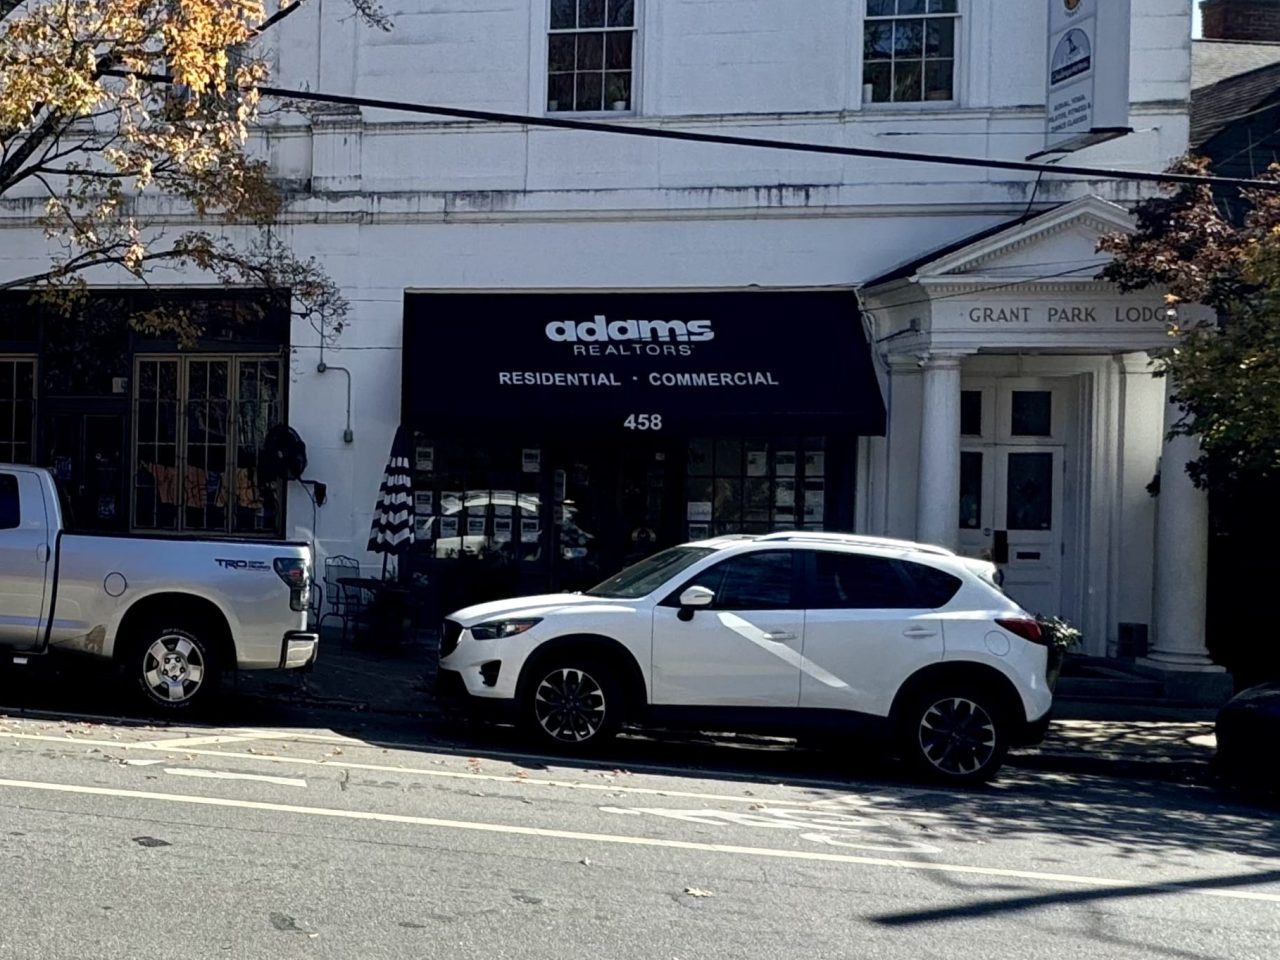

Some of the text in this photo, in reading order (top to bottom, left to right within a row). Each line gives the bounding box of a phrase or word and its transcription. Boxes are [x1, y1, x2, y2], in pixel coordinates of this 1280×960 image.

[969, 306, 1032, 323] GRANT
[1048, 306, 1097, 323] PARK
[545, 314, 715, 342] adams
[499, 371, 779, 387] RESIDENTIAL COMMERCIAL
[623, 413, 663, 430] 458
